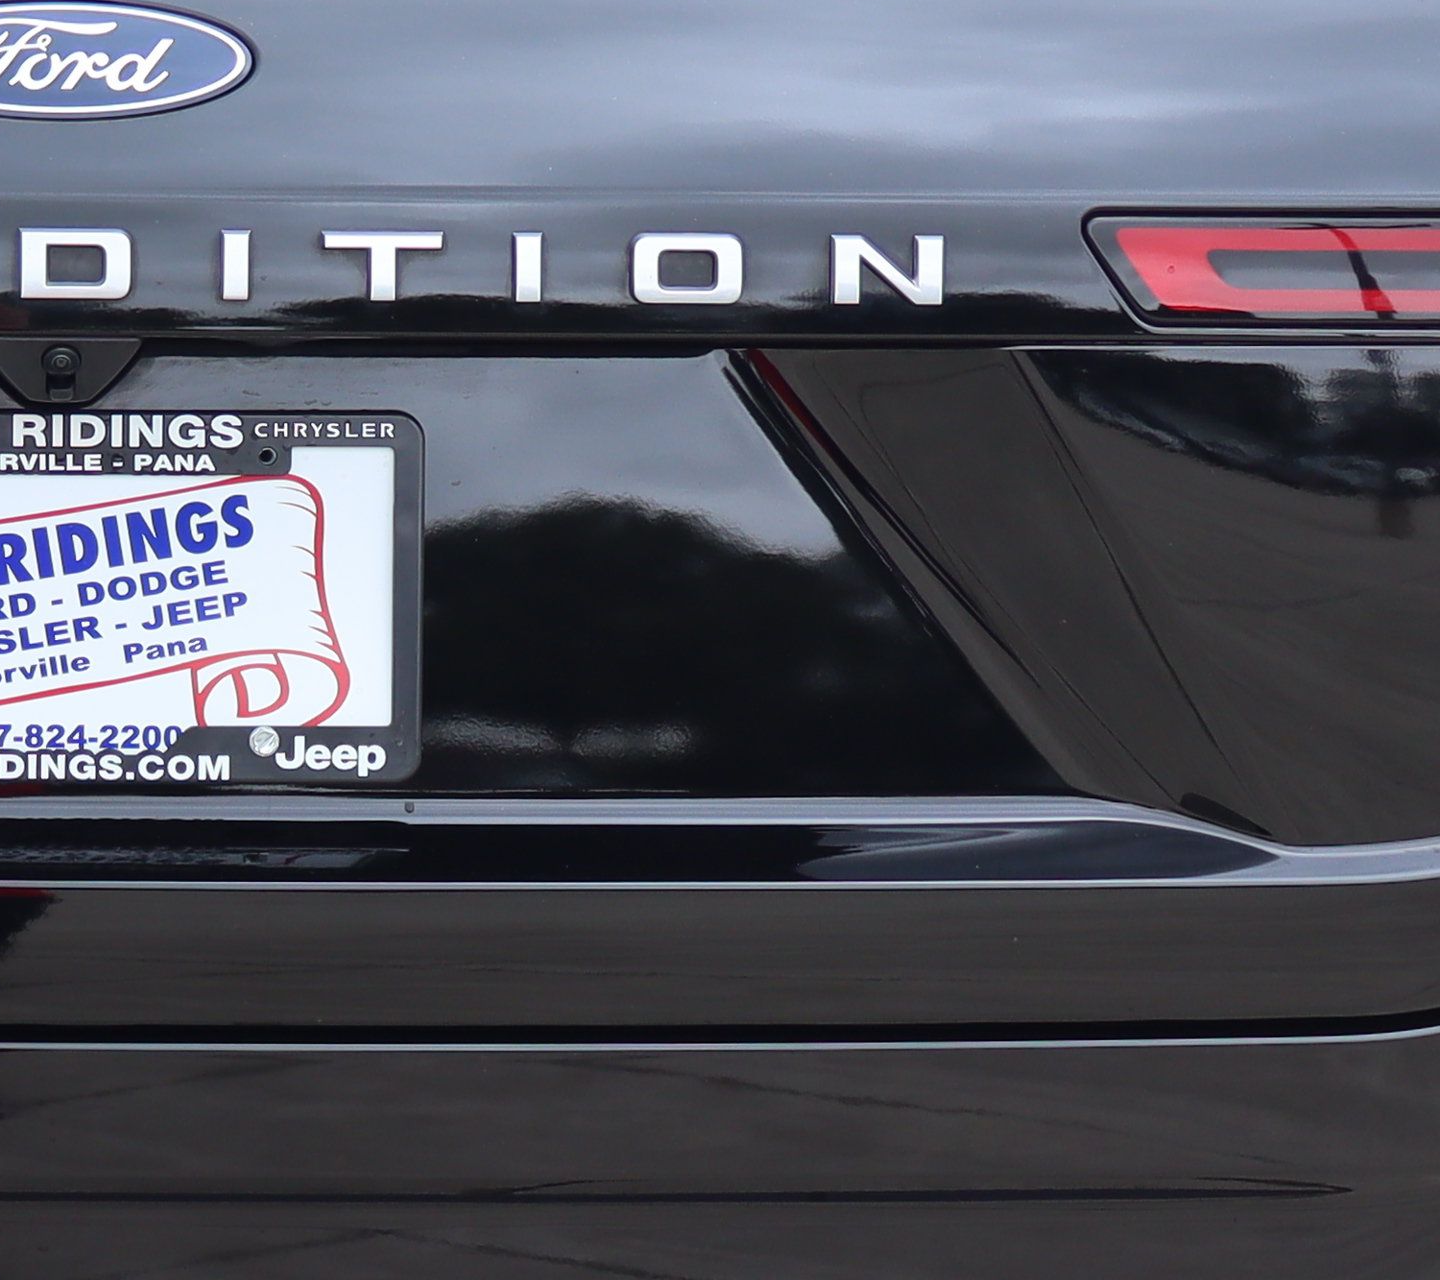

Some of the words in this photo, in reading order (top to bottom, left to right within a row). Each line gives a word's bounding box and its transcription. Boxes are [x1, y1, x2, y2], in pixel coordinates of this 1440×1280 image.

[12, 414, 244, 449] RIDINGS
[254, 422, 395, 439] CHRYSLER
[134, 454, 216, 472] PANA
[78, 560, 229, 607] DODGE
[142, 591, 248, 630] JEEP
[123, 636, 208, 664] Pana
[275, 735, 387, 777] Jeep
